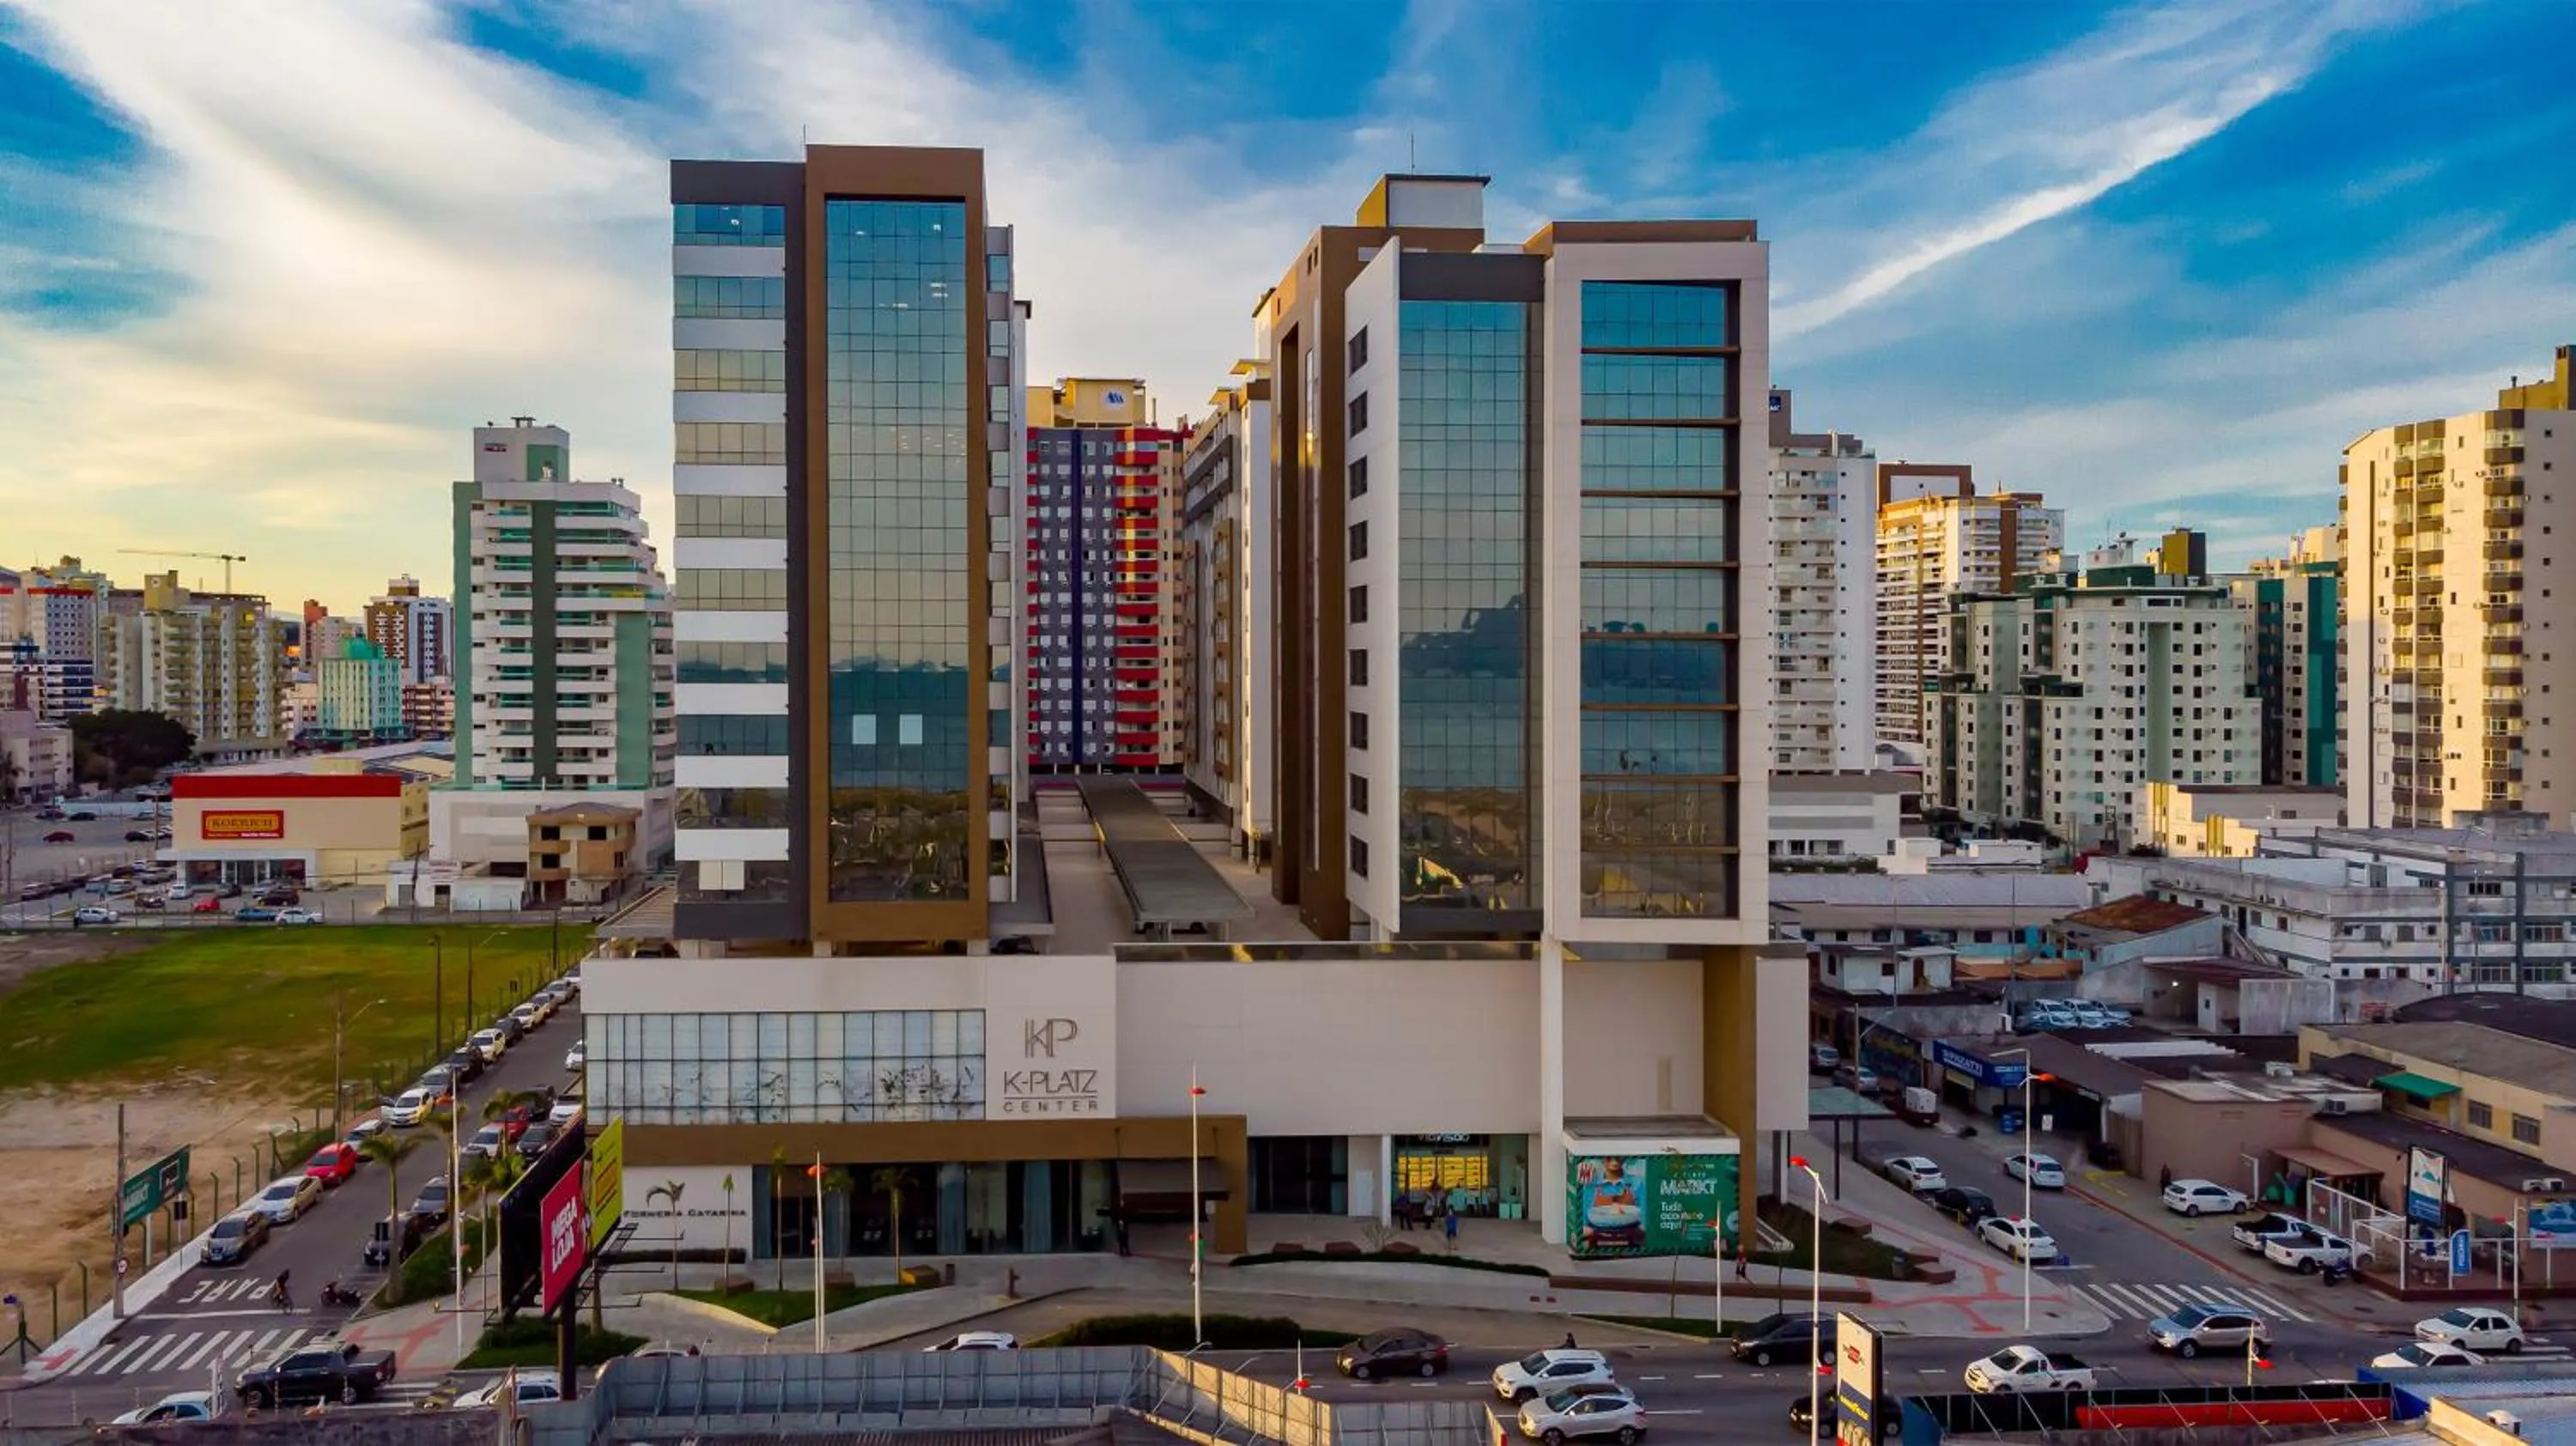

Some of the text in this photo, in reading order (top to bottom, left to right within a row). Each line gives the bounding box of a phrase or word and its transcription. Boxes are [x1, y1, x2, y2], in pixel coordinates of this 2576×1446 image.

[1004, 1070, 1098, 1094] K-PLATZ
[1003, 1101, 1097, 1113] CENTER
[551, 1196, 578, 1243] MEGA
[688, 1208, 747, 1218] CATARNA
[551, 1228, 574, 1273] LOJA
[177, 1277, 278, 1303] PARE
